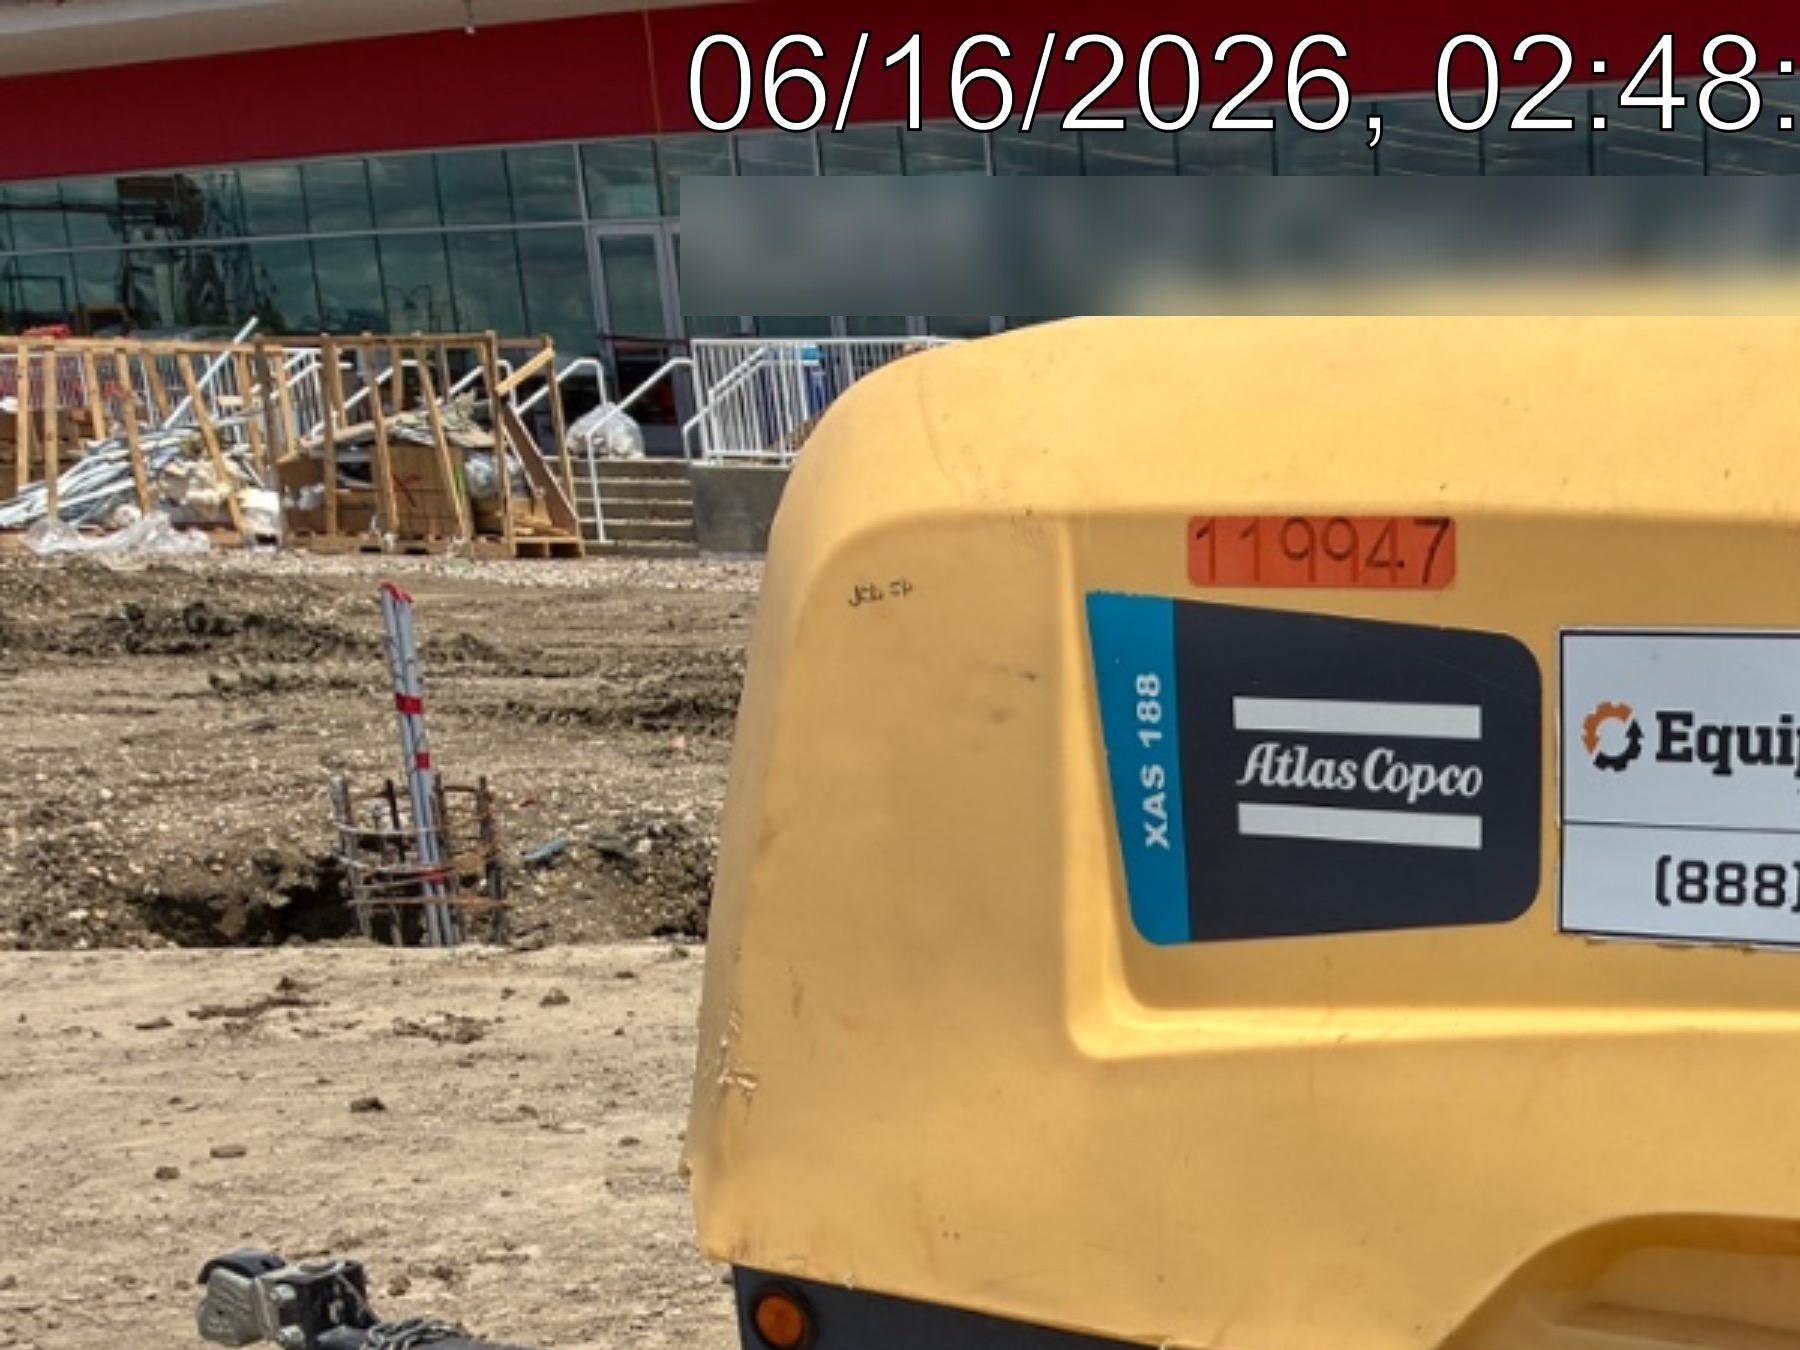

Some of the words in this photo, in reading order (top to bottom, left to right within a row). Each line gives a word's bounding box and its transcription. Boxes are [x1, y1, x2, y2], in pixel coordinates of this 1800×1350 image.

[1194, 515, 1452, 586] 119947
[1134, 672, 1164, 750] 188
[1139, 762, 1172, 850] XAS
[1236, 741, 1358, 792] Atlas
[1362, 747, 1484, 804] Copco
